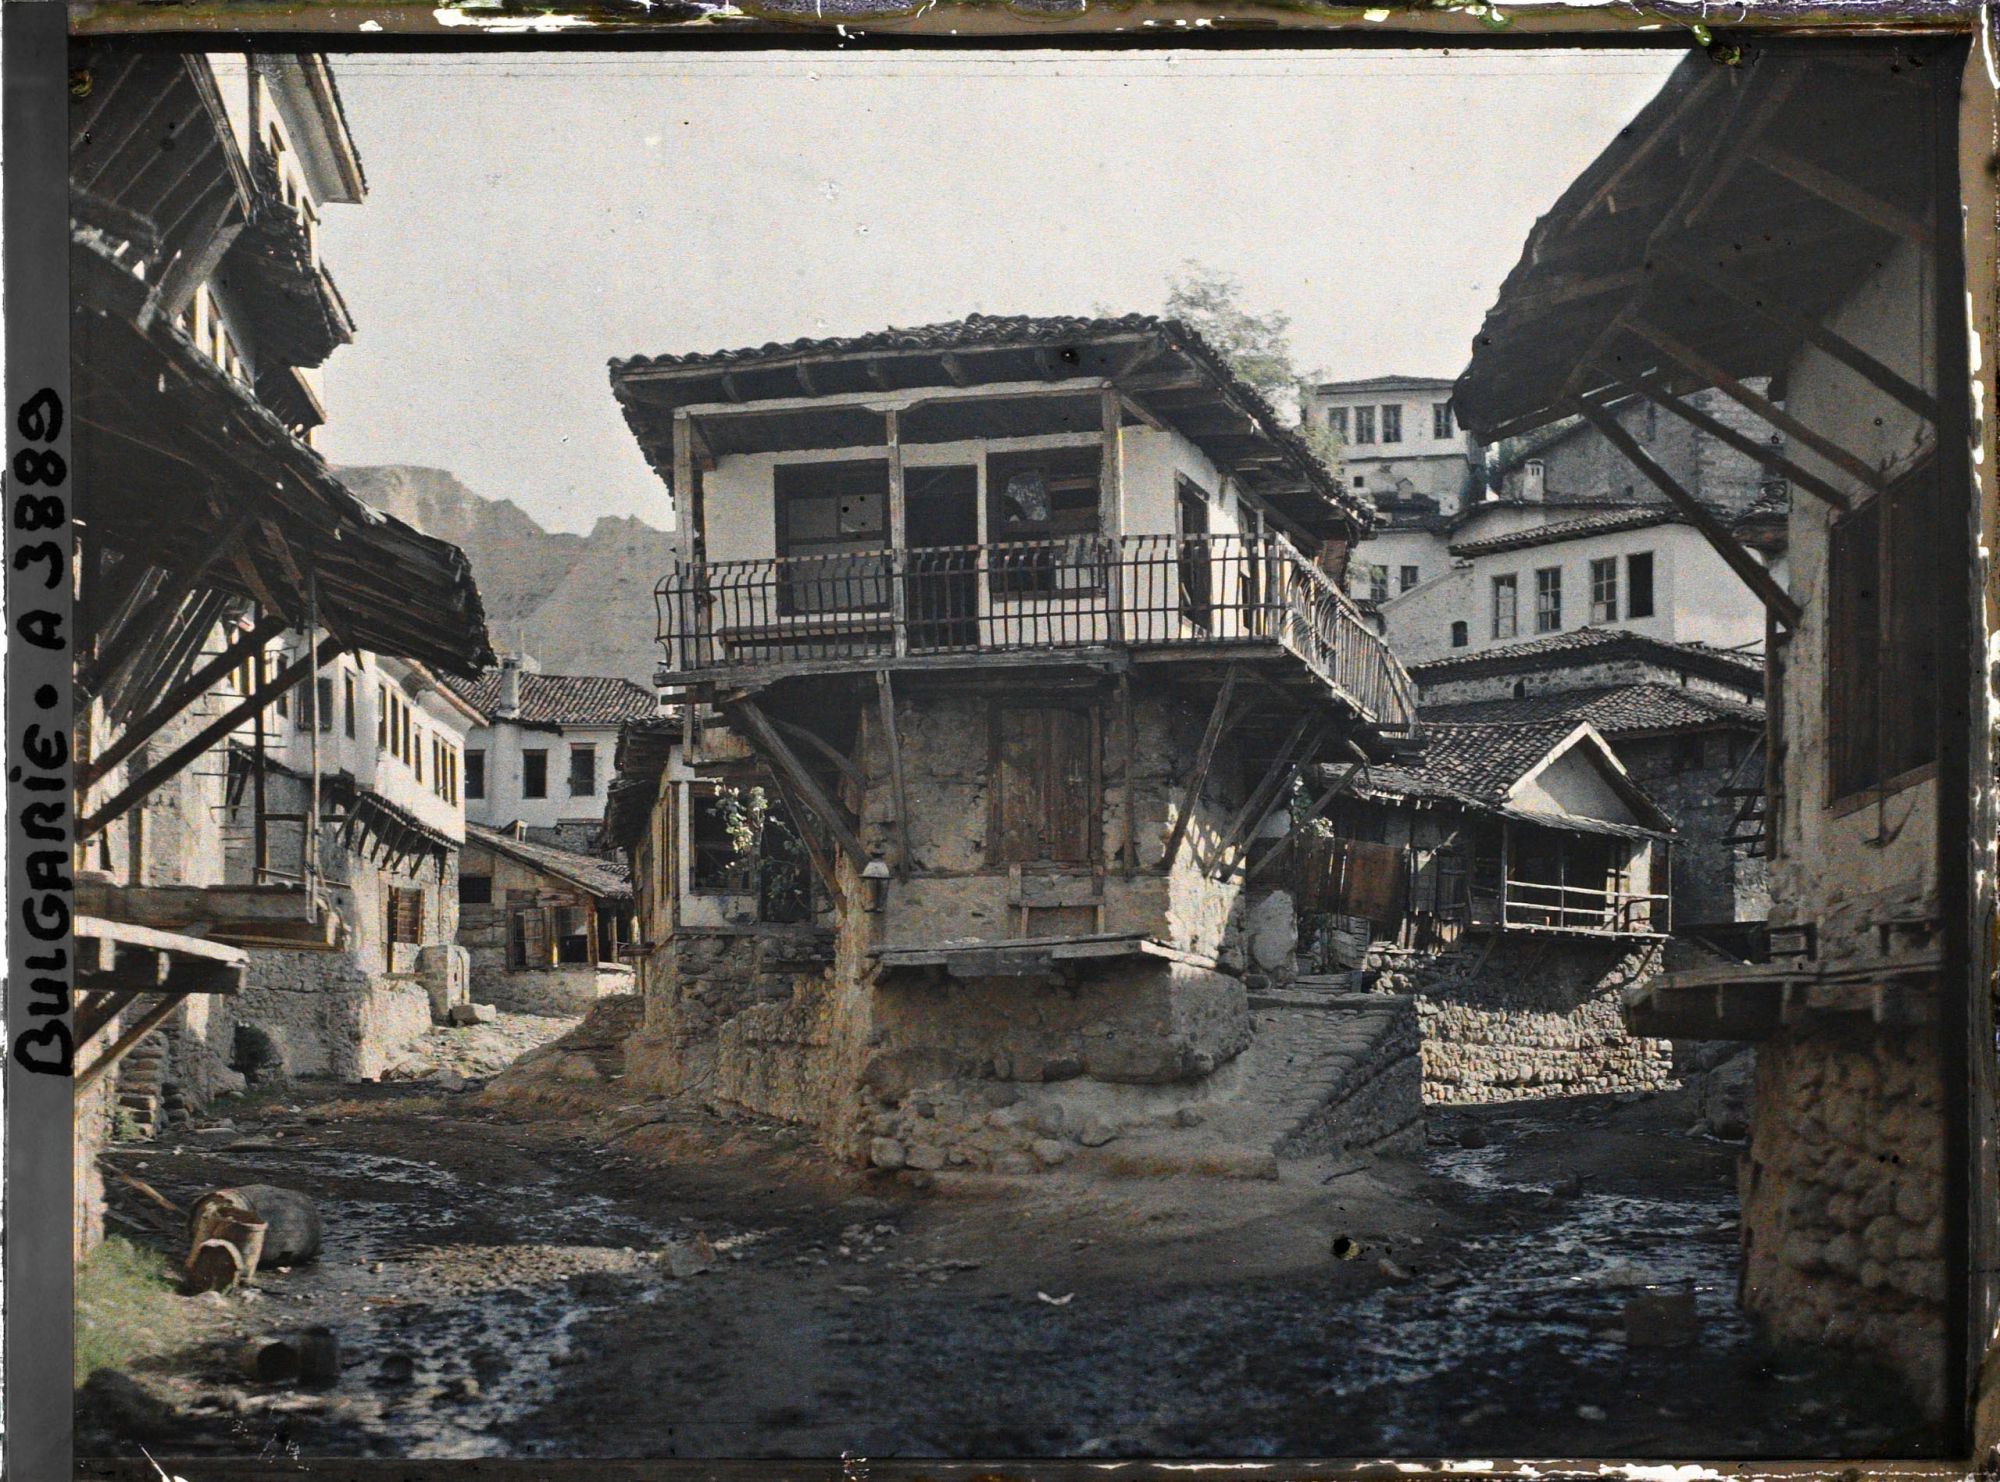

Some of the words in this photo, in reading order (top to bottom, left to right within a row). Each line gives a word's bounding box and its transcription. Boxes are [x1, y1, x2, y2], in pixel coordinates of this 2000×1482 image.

[13, 387, 66, 590] 3889
[17, 610, 66, 651] A
[10, 724, 73, 1076] BULGARIE
